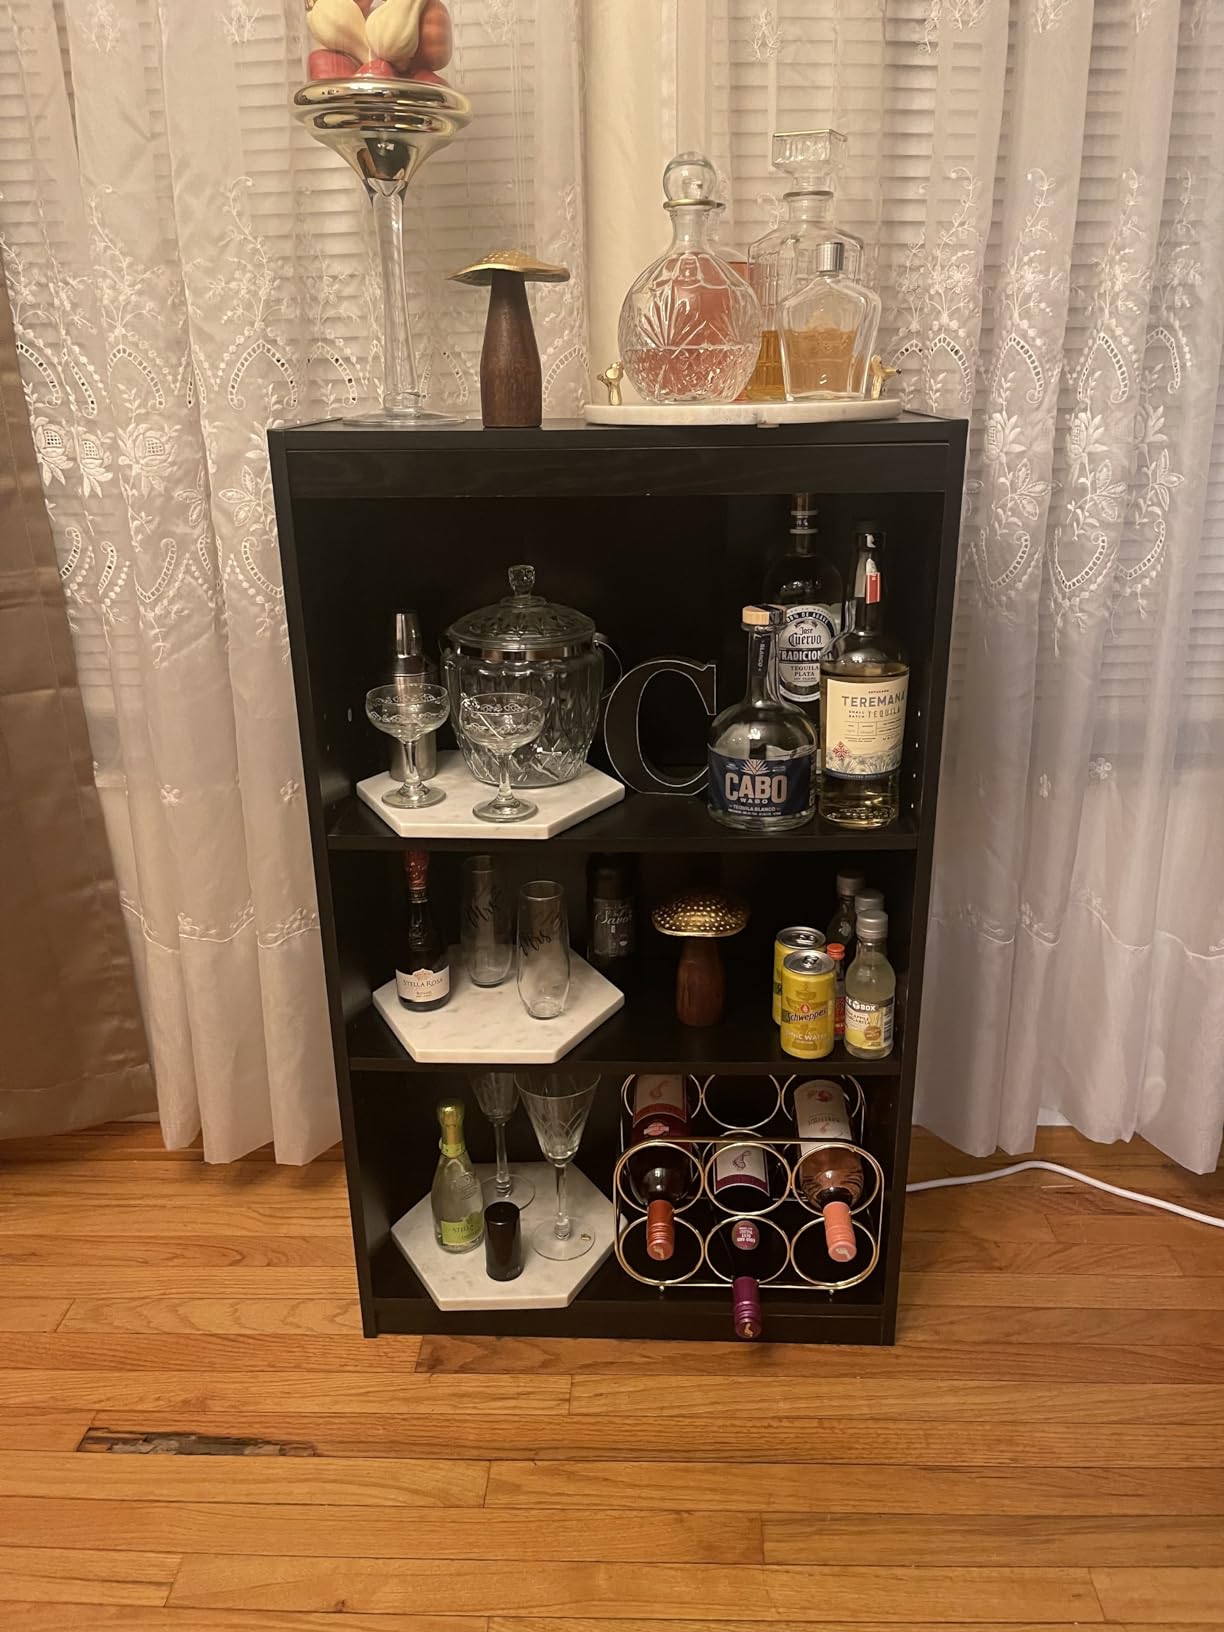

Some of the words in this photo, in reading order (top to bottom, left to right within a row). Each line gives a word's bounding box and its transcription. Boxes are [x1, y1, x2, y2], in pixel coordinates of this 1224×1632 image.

[788, 632, 822, 648] Cuervo
[841, 689, 906, 708] TEREMANA
[867, 706, 901, 719] TEQUILA
[725, 772, 788, 804] CABO
[733, 804, 754, 812] TEQUILA
[403, 979, 426, 988] STELLA
[426, 978, 443, 987] ROSA
[861, 1003, 876, 1012] BOX
[787, 1008, 828, 1023] Schweppes
